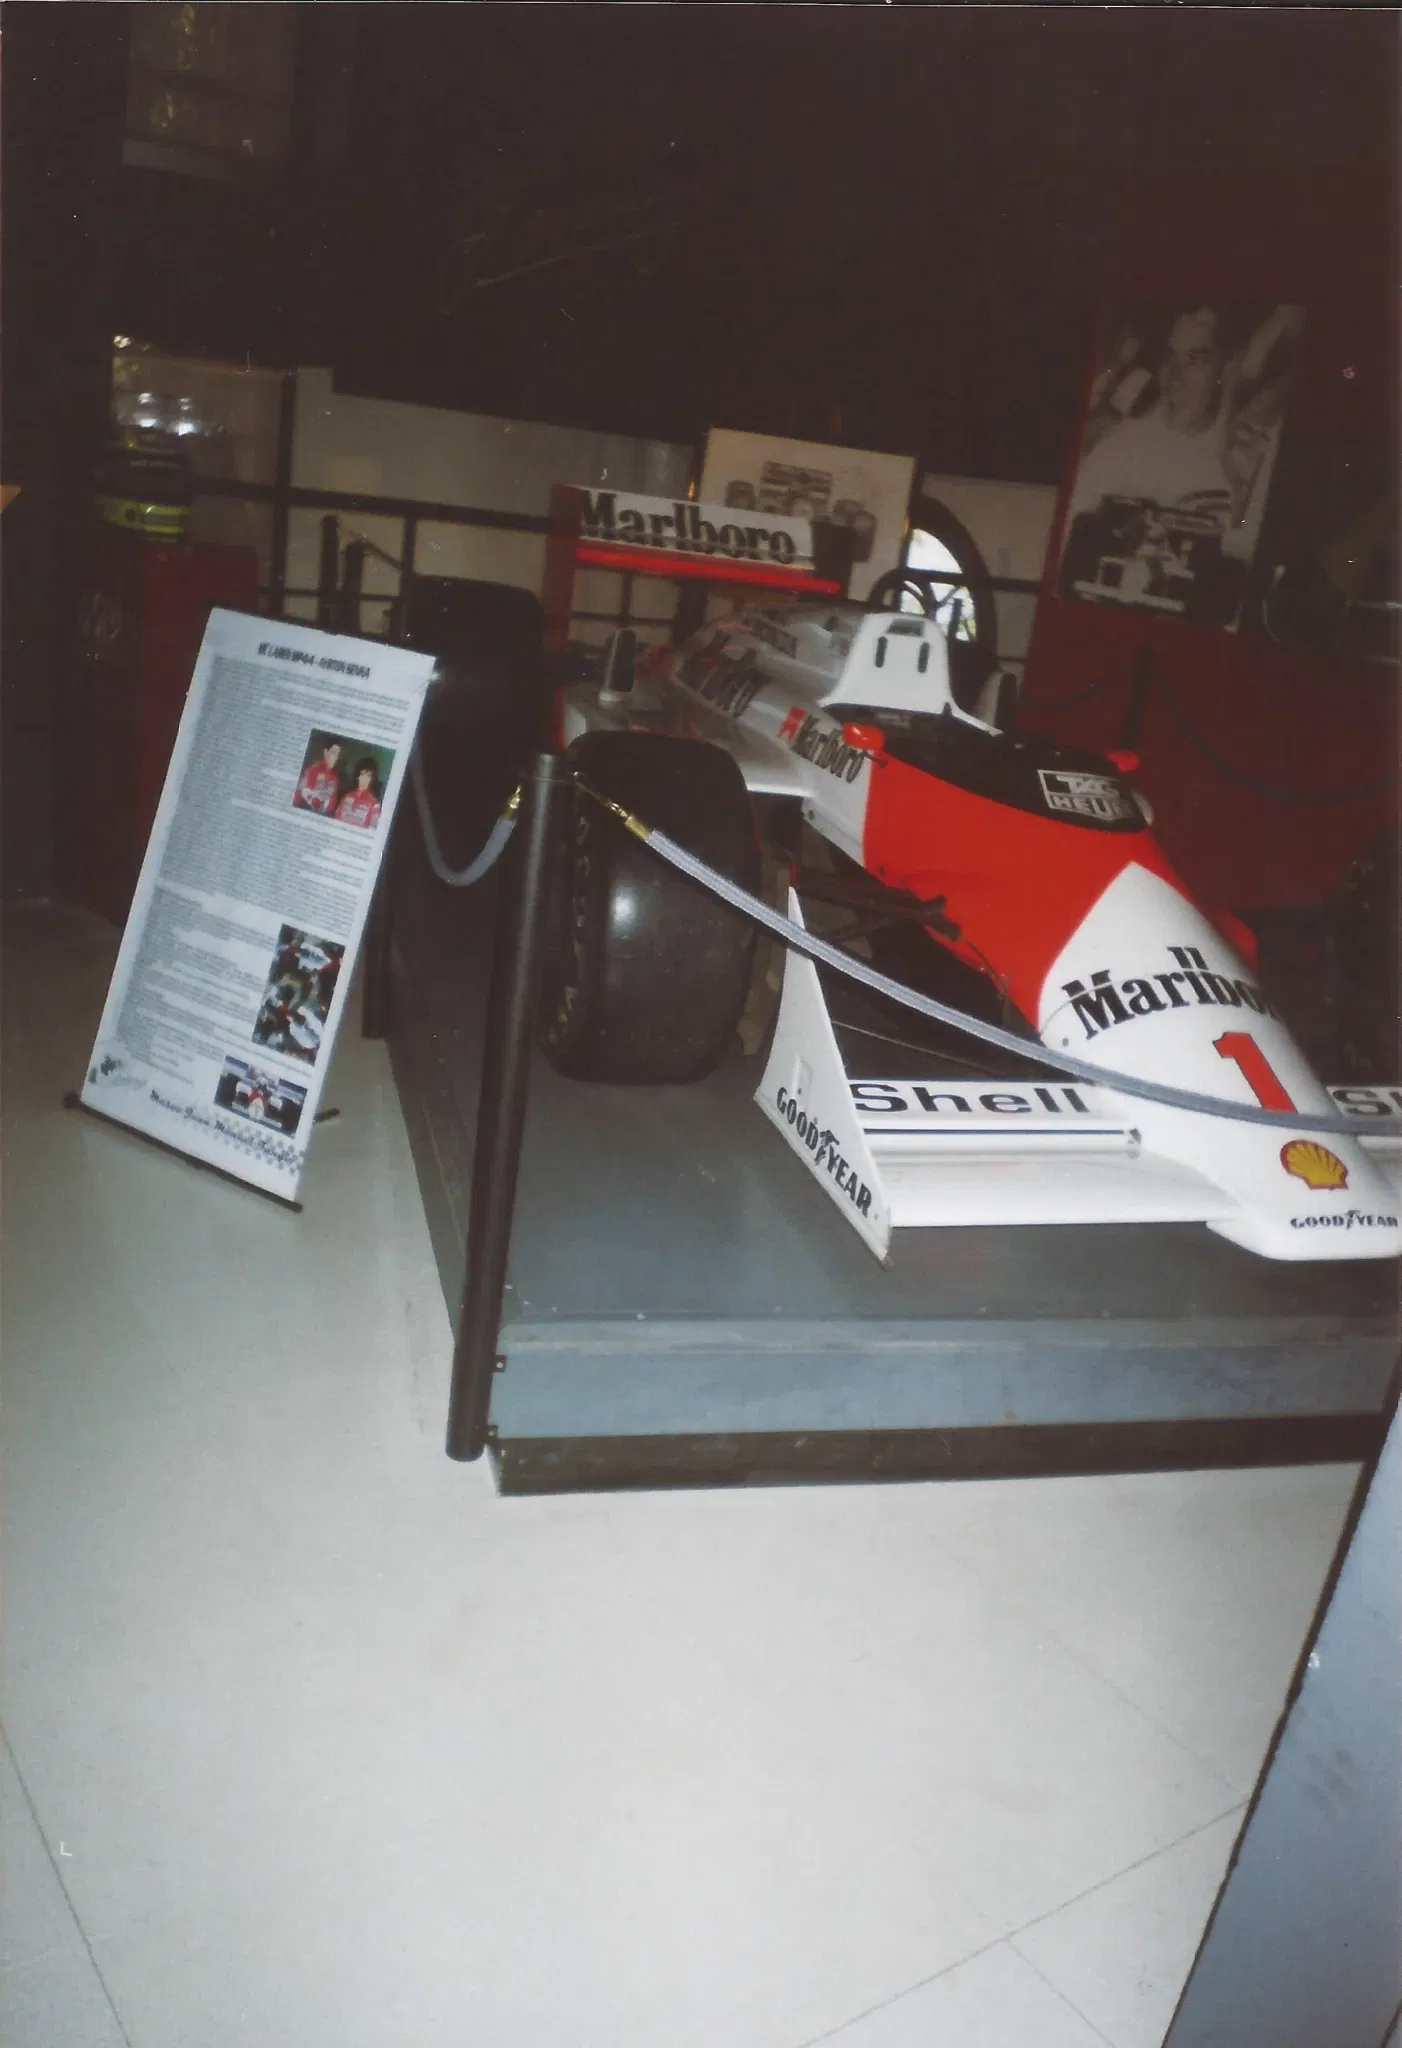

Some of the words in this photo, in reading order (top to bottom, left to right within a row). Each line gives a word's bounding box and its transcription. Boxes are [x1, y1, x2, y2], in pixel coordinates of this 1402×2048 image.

[581, 490, 796, 564] Marlboro
[853, 1083, 1092, 1114] Shell
[1213, 1032, 1298, 1116] 1
[777, 1087, 872, 1218] GOODYEAR
[1290, 1209, 1398, 1231] GOODYEAR
